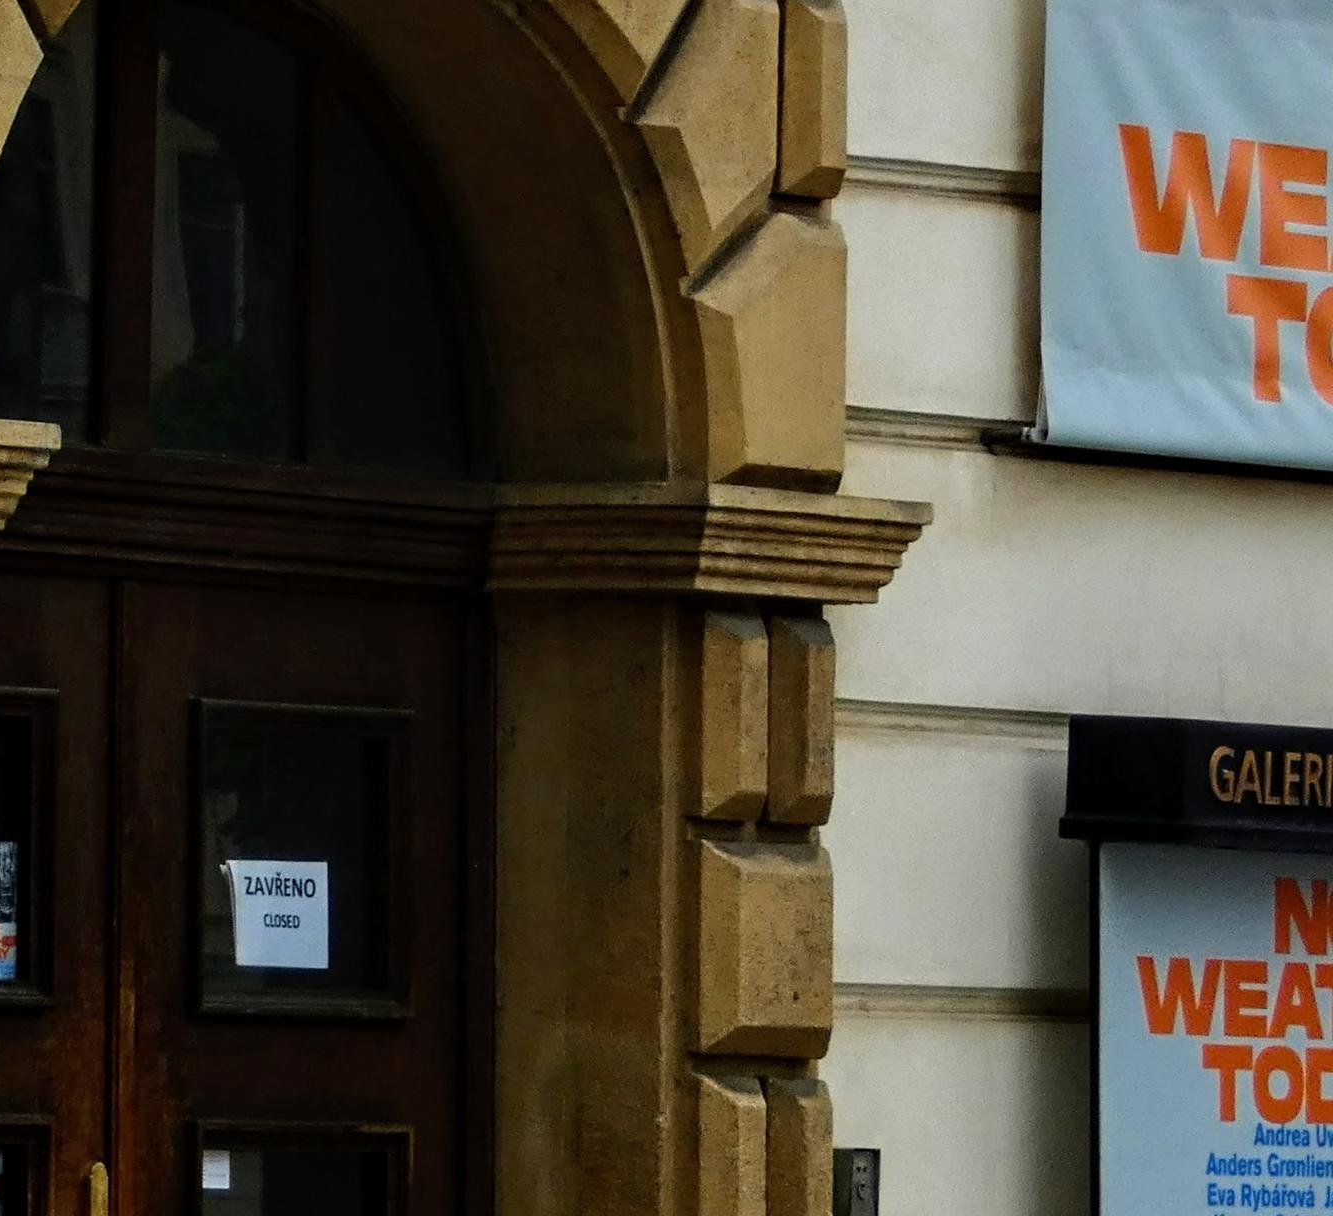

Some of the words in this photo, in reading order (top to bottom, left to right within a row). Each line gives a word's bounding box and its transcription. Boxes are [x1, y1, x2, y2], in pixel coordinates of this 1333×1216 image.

[1118, 123, 1333, 272] WE
[244, 871, 316, 898] ZAVŘENO
[263, 913, 300, 929] CLOSED
[1274, 876, 1333, 956] N
[1254, 1123, 1310, 1146] Andrea
[1205, 1152, 1262, 1176] Anders
[1207, 1183, 1235, 1206] Eva
